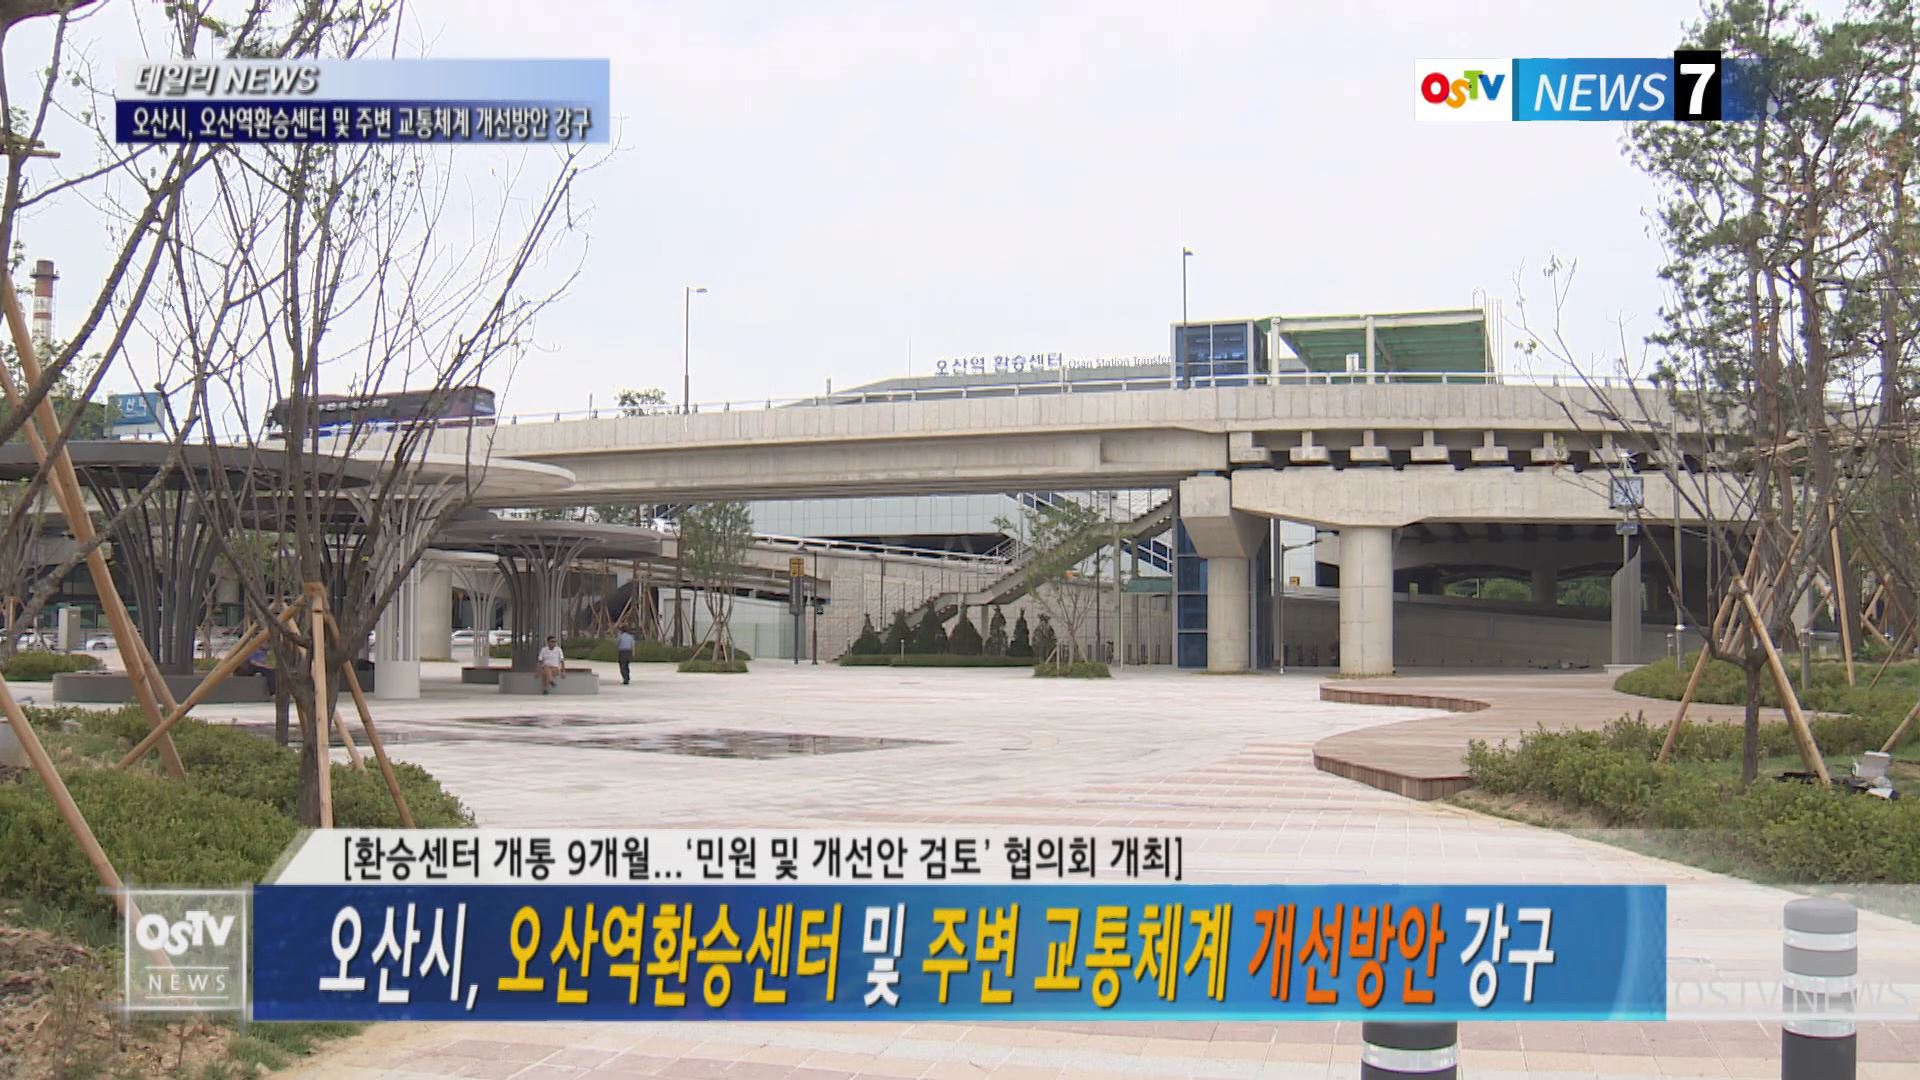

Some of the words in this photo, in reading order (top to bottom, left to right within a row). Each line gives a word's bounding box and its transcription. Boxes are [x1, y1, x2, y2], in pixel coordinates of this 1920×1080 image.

[935, 356, 985, 376] 오산역
[993, 352, 1063, 373] 환승센터
[1068, 359, 1092, 369] Osan
